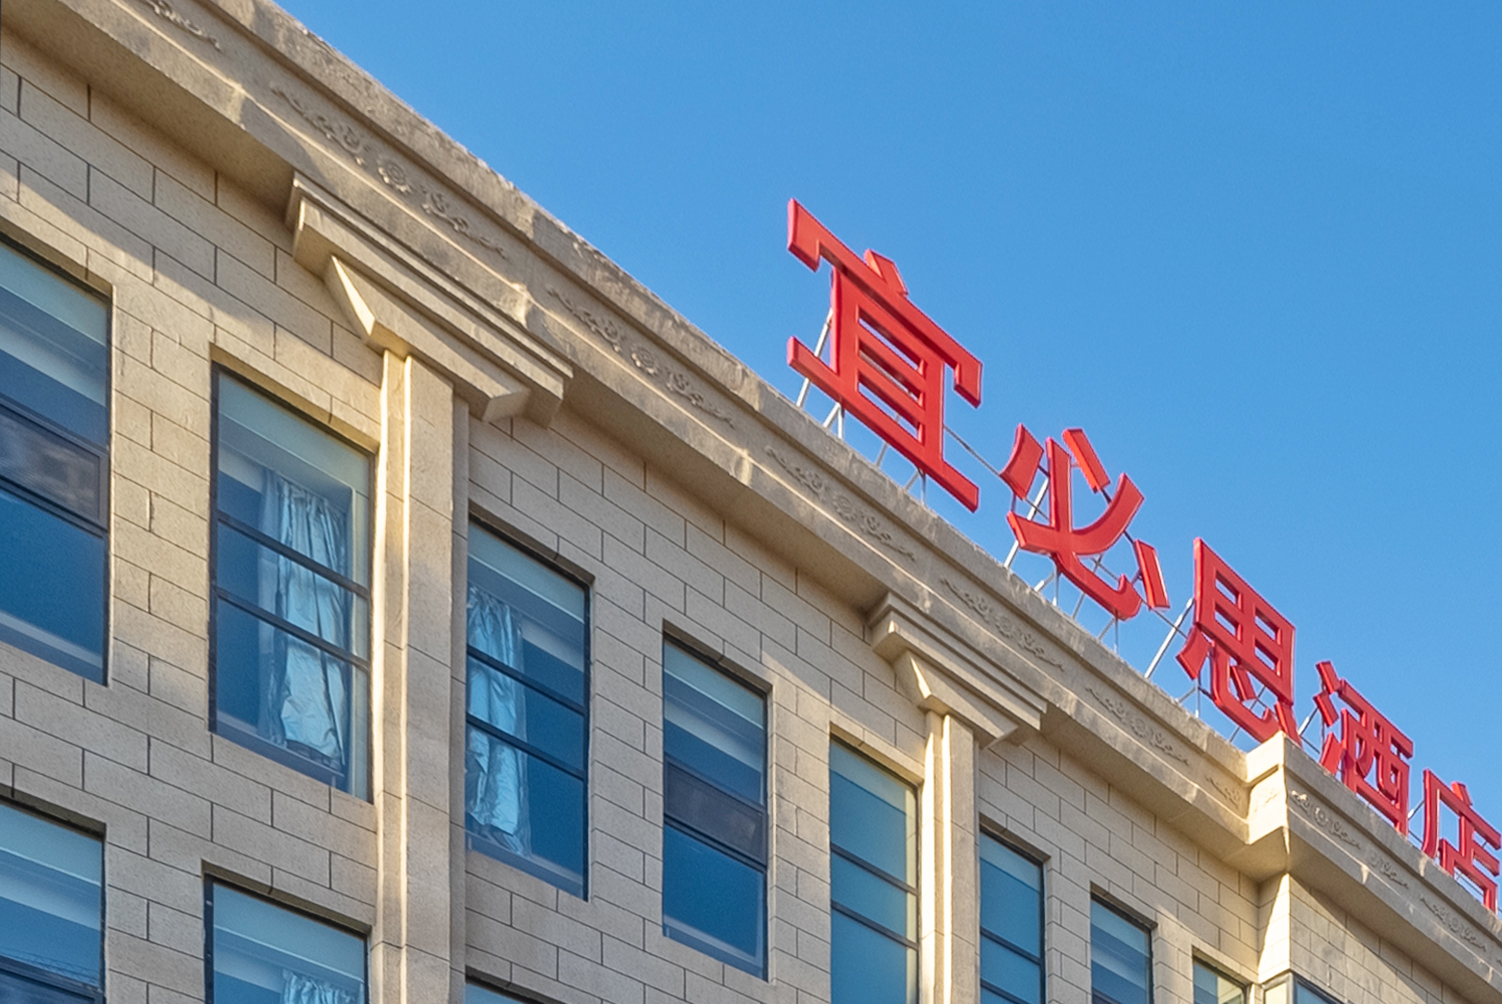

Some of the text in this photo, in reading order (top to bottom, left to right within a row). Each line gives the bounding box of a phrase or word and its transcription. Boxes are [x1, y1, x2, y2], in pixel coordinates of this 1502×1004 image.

[787, 198, 1502, 916] 宜必思酒店
